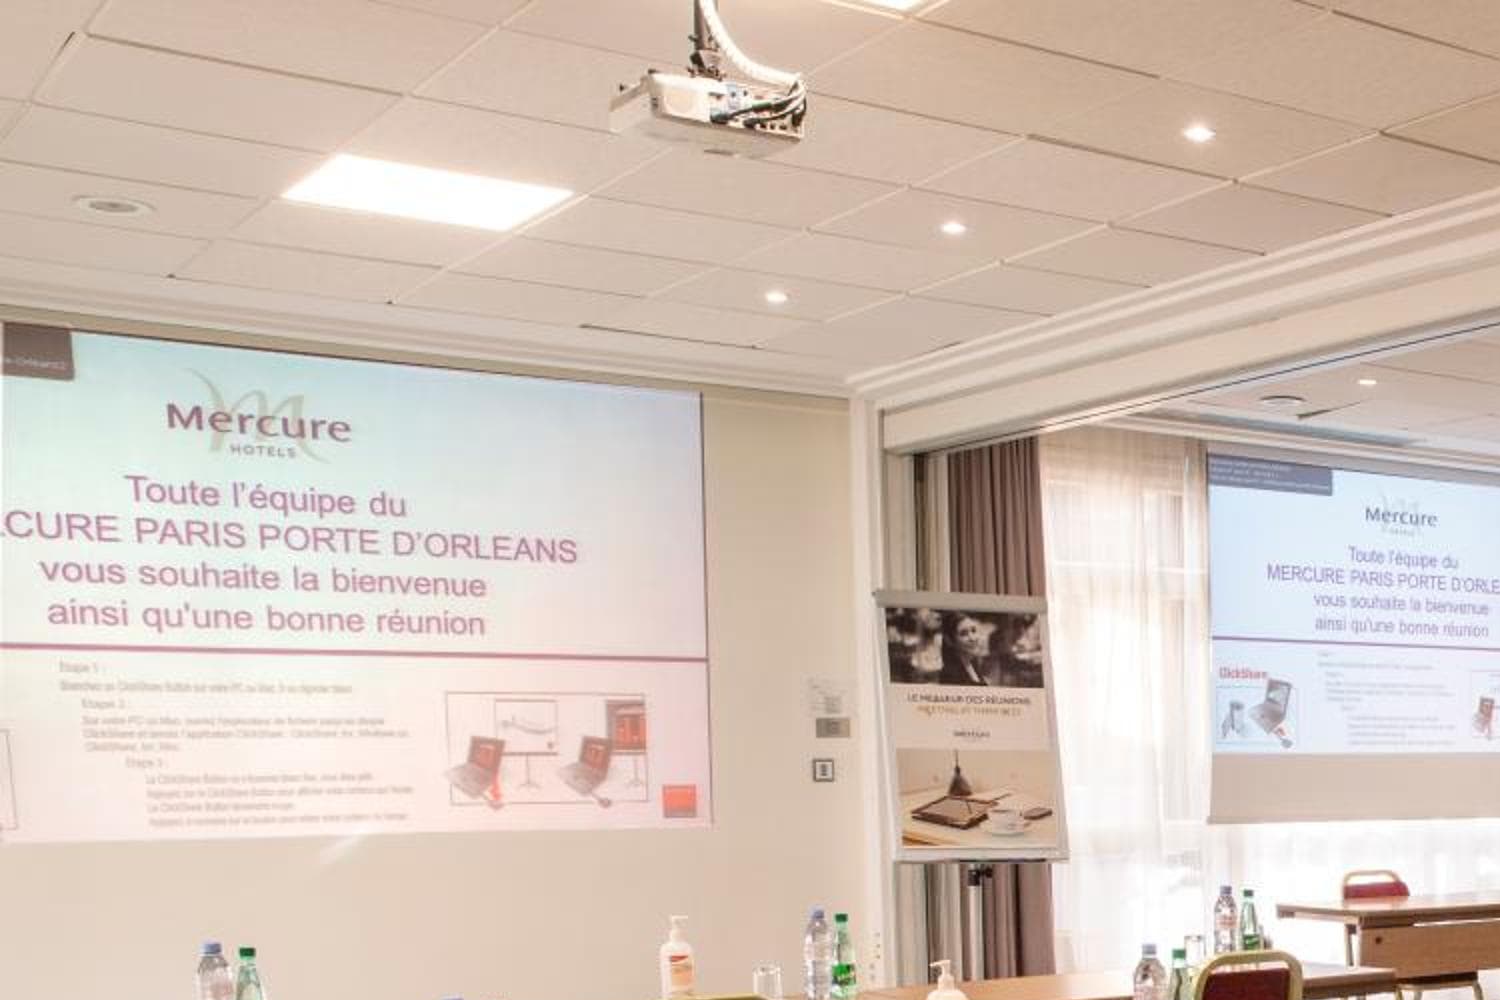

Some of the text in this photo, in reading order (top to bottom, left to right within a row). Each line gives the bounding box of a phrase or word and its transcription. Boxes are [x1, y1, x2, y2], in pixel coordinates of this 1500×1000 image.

[166, 402, 352, 443] Mercure
[229, 443, 297, 459] HOTELS
[124, 474, 407, 518] Toute l'équipe du
[1365, 505, 1438, 528] Mercure
[0, 509, 578, 564] CURE PARIS PORTE D'ORLEANS
[39, 560, 487, 598] vous souhaite la bienvenue
[1267, 562, 1345, 585] MERCURE
[1350, 569, 1394, 587] PARIS
[1397, 572, 1447, 591] PORTE
[47, 598, 485, 636] ainsi qu'une bonne réunion
[1313, 594, 1346, 608] vous
